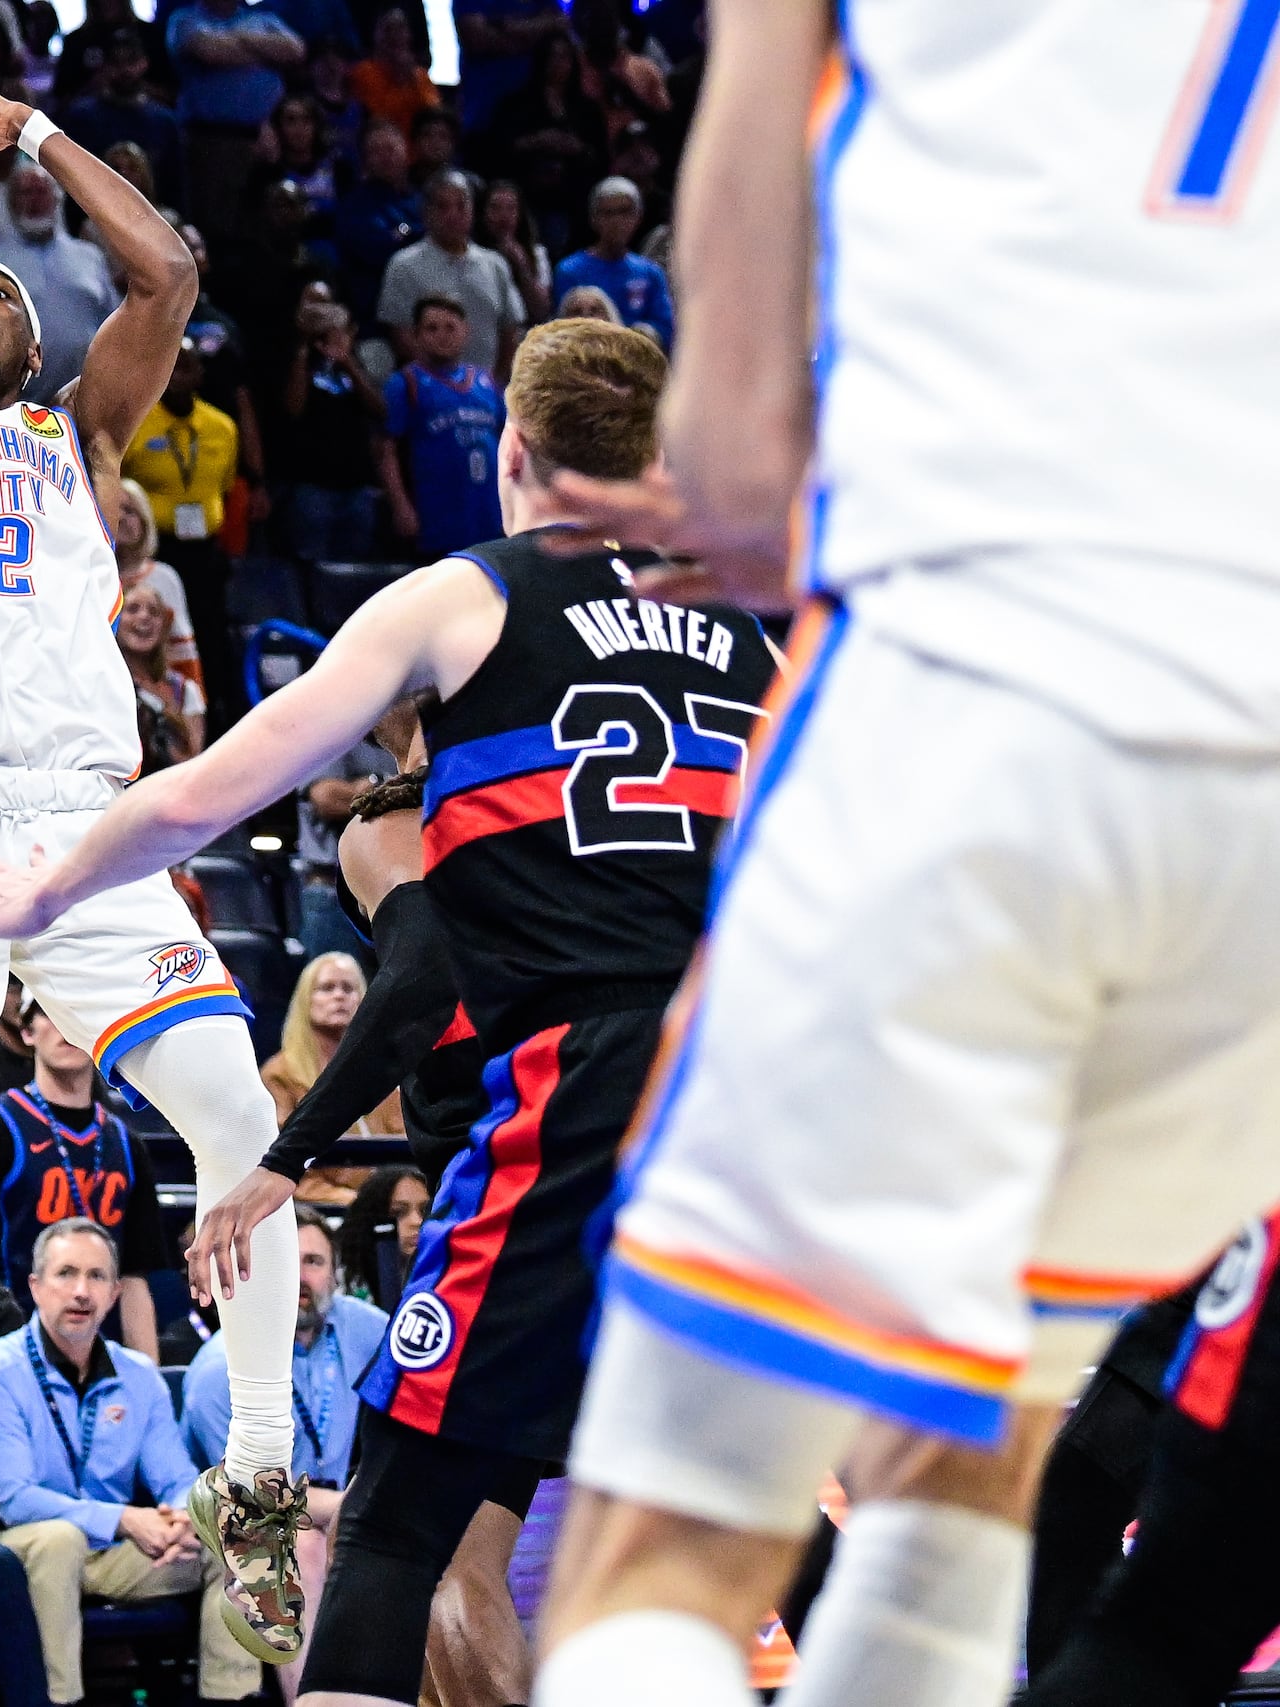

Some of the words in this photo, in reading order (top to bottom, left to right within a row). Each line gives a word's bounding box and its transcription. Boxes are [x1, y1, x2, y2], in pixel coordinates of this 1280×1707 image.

[563, 597, 734, 673] HUERTER
[158, 948, 195, 984] OKC
[36, 1166, 127, 1227] OKC
[399, 1311, 441, 1350] DET
